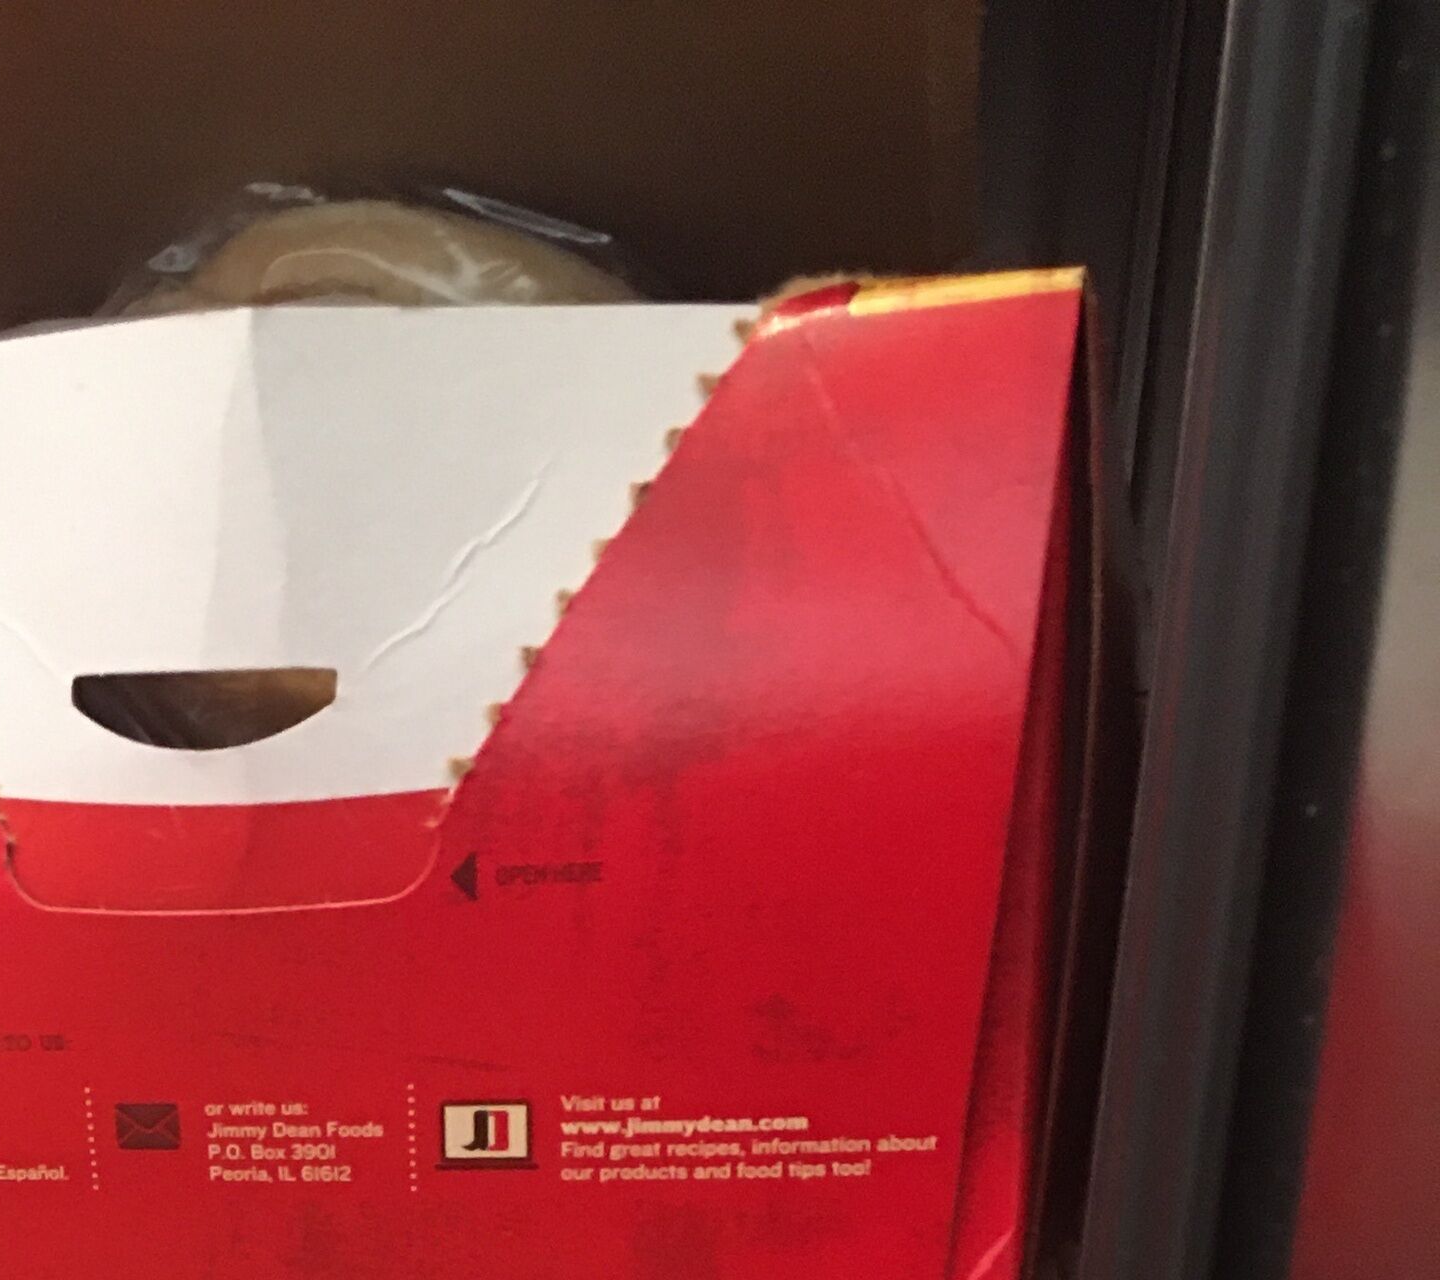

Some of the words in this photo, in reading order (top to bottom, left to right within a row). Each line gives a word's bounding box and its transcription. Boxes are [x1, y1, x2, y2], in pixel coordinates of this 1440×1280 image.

[205, 1104, 222, 1115] or
[229, 1102, 276, 1115] write
[281, 1104, 308, 1115] us:
[560, 1095, 606, 1112] Visit
[611, 1098, 635, 1112] us
[641, 1096, 661, 1111] at
[208, 1122, 267, 1140] Jimmy
[272, 1123, 320, 1138] Dean
[326, 1121, 383, 1138] Foods
[561, 1114, 809, 1137] www.jimmydean.com
[251, 1144, 285, 1160] Box
[561, 1142, 604, 1158] Find
[610, 1141, 661, 1160] great
[666, 1140, 746, 1159] recipes,
[752, 1136, 871, 1155] information
[877, 1135, 938, 1152] about
[210, 1165, 273, 1183] Peoria,
[278, 1167, 296, 1181] IL
[560, 1166, 593, 1181] our
[600, 1165, 688, 1183] products
[694, 1163, 731, 1180] and
[737, 1162, 783, 1179] food
[788, 1162, 826, 1179] tips
